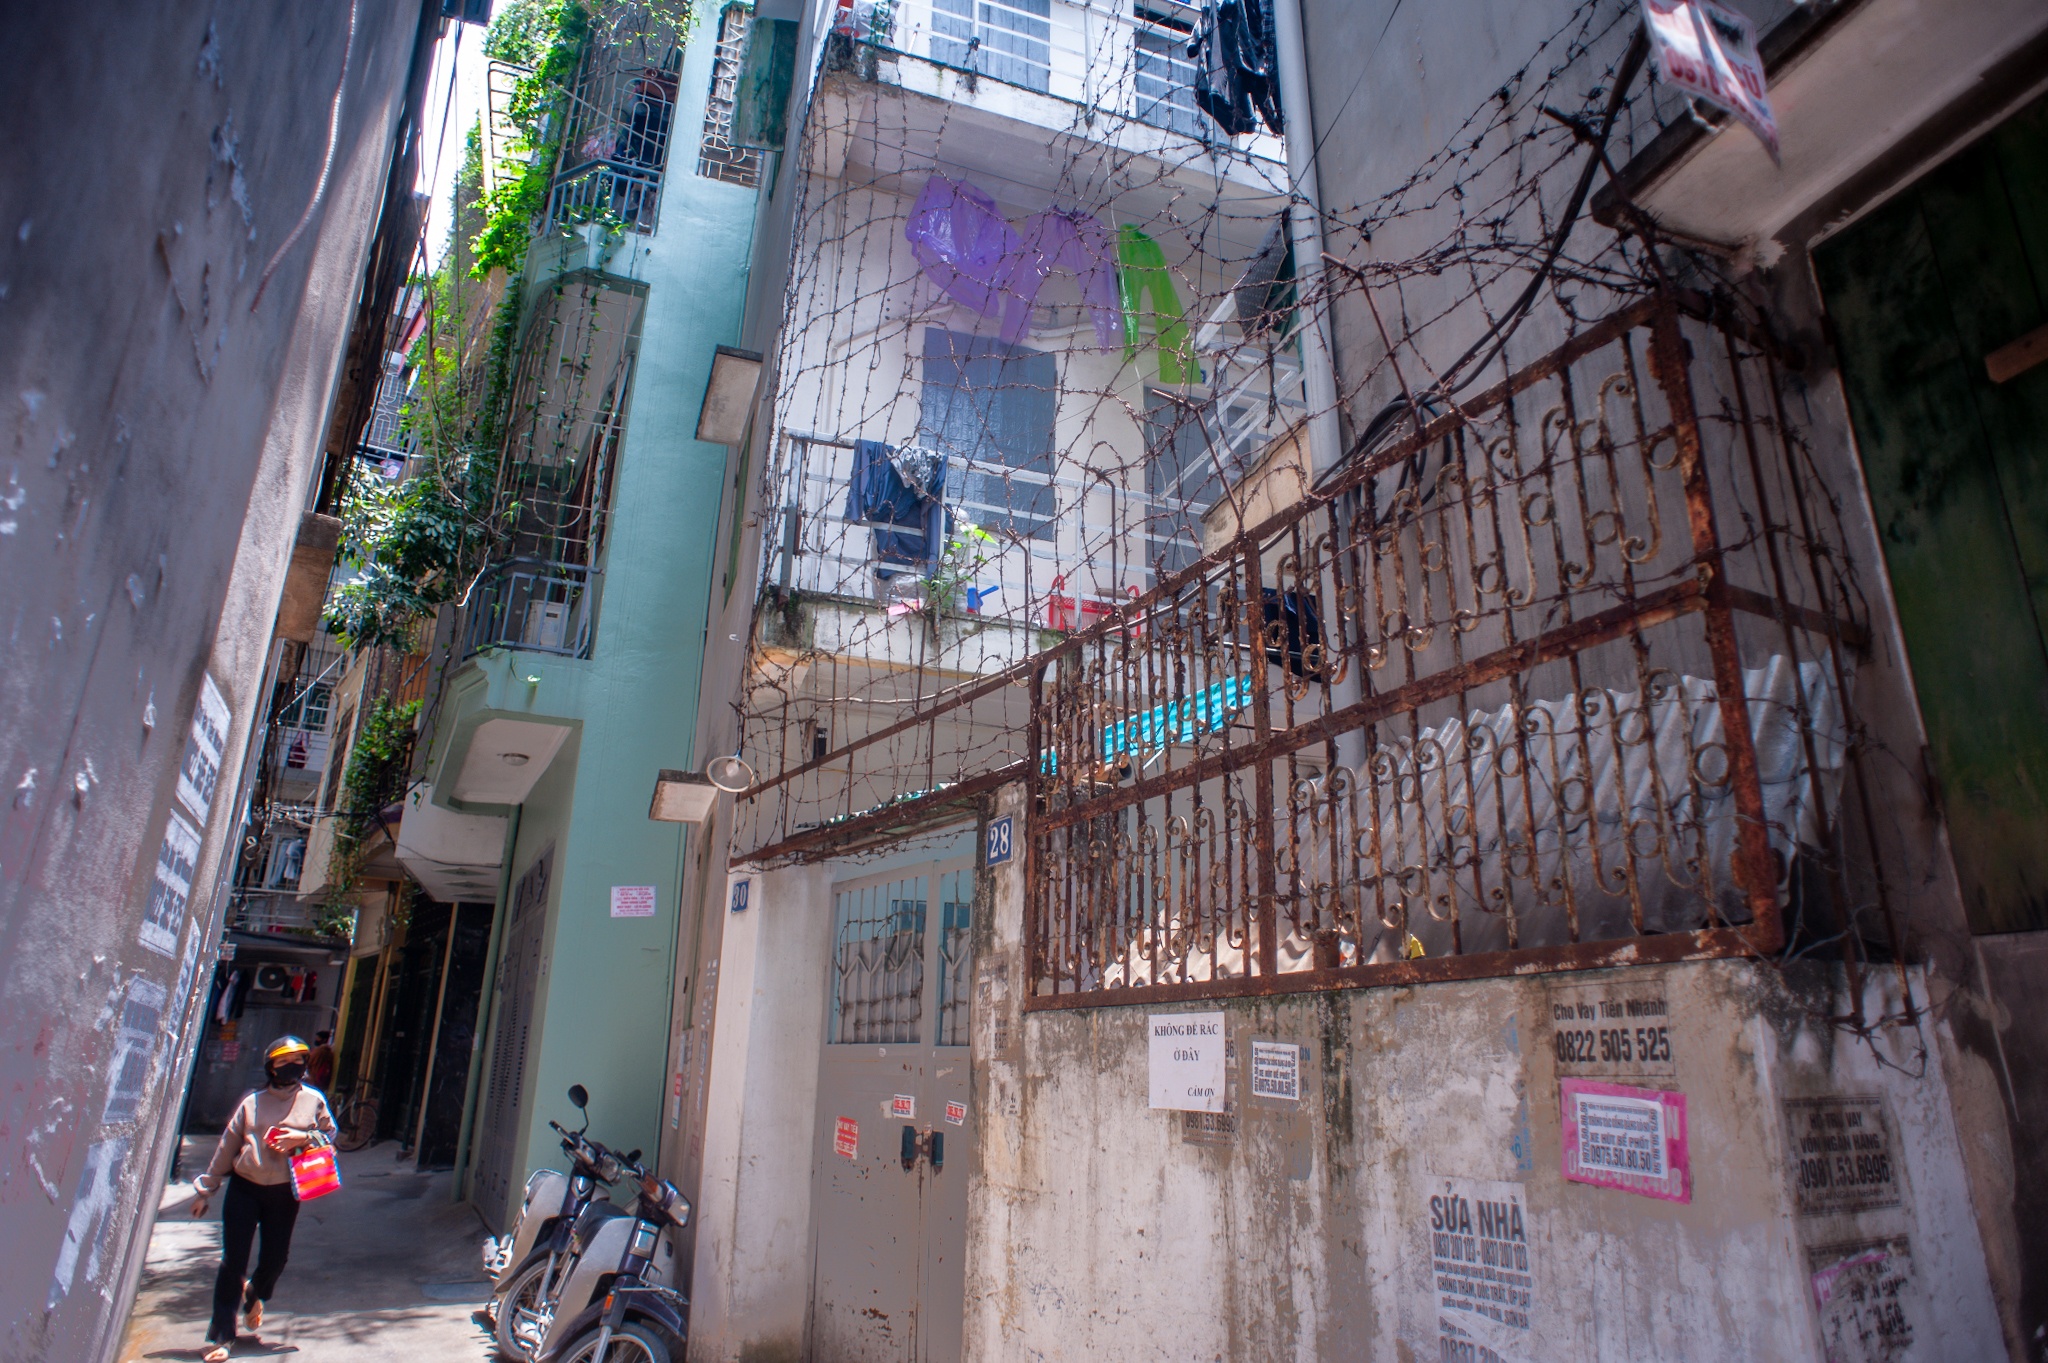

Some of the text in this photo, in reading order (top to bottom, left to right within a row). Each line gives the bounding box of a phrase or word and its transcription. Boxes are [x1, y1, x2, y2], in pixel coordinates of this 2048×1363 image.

[990, 822, 1010, 859] 28
[732, 884, 747, 909] 30
[1553, 1003, 1574, 1021] Cho
[1576, 1002, 1596, 1021] Vay
[1626, 997, 1668, 1017] Nhanh
[1154, 1022, 1185, 1037] KHÔNG
[1200, 1020, 1219, 1036] RÁC
[1182, 1047, 1201, 1062] ĐÂY
[1556, 1026, 1671, 1063] 0822 505 525
[1845, 1110, 1864, 1128] VAY
[1590, 1144, 1653, 1172] 0975.50.80.50
[1800, 1154, 1891, 1189] 0981.53.6996
[1429, 1180, 1527, 1243] SỬA NHÀ
